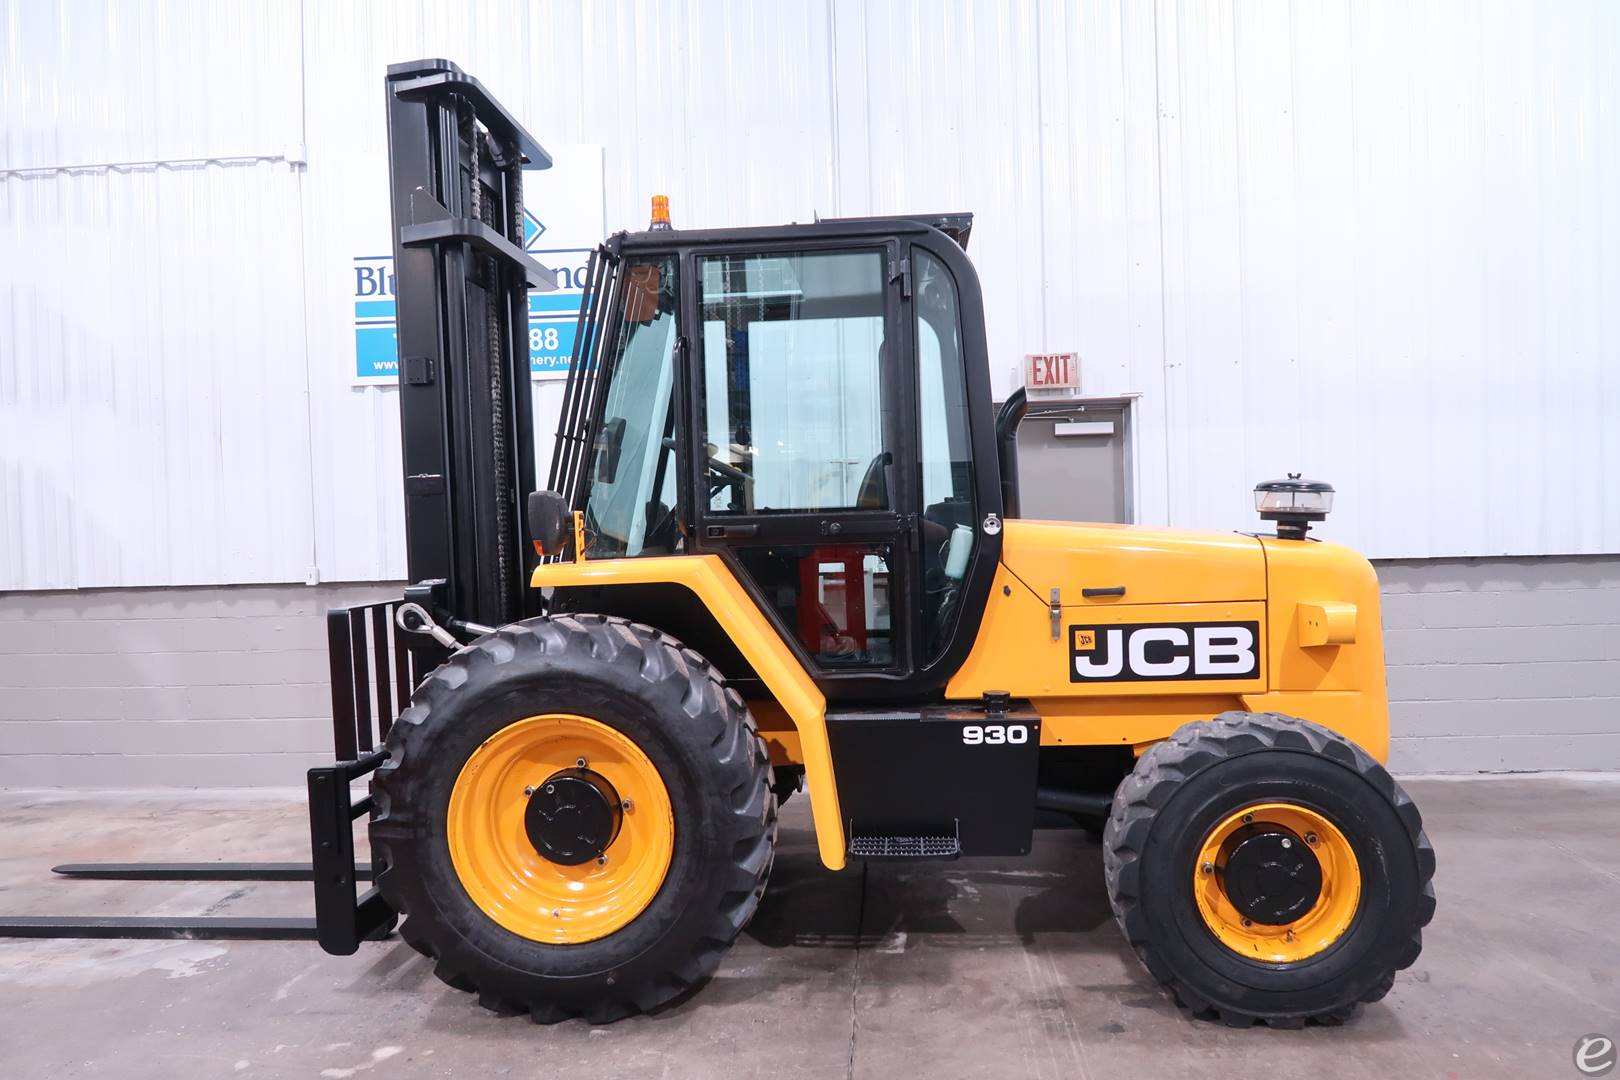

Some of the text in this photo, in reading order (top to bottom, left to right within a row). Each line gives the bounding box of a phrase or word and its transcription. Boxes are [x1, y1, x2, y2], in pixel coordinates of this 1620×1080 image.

[1032, 355, 1071, 385] EXIT
[1075, 626, 1255, 677] JCB
[962, 725, 1028, 744] 930
